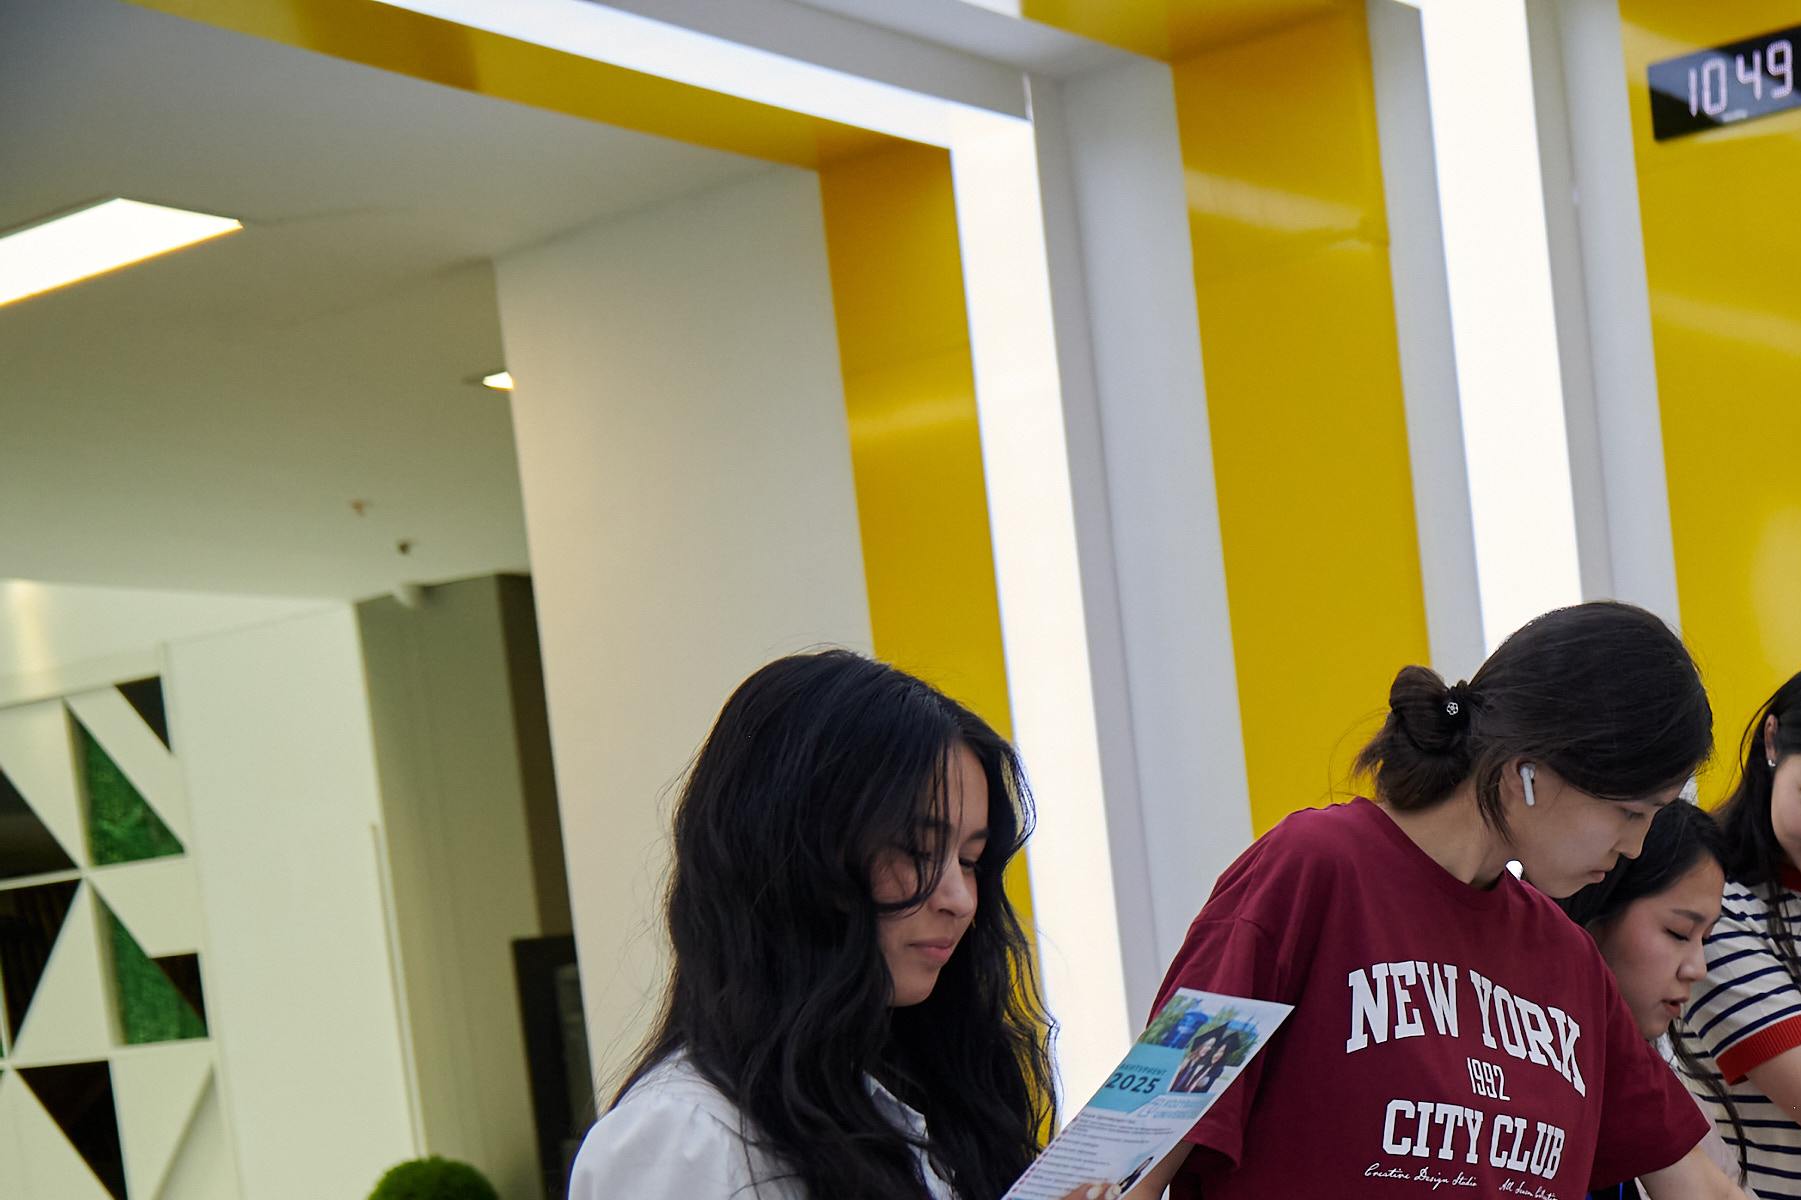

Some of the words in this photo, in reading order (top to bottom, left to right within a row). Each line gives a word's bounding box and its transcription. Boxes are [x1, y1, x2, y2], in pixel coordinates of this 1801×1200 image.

[1346, 960, 1459, 1054] NEW
[1469, 969, 1586, 1098] YORK
[1105, 1072, 1161, 1094] 2025
[1466, 1057, 1511, 1101] 1992
[1382, 1099, 1484, 1164] CITY
[1489, 1114, 1566, 1180] CLUB
[1413, 1166, 1449, 1191] Design
